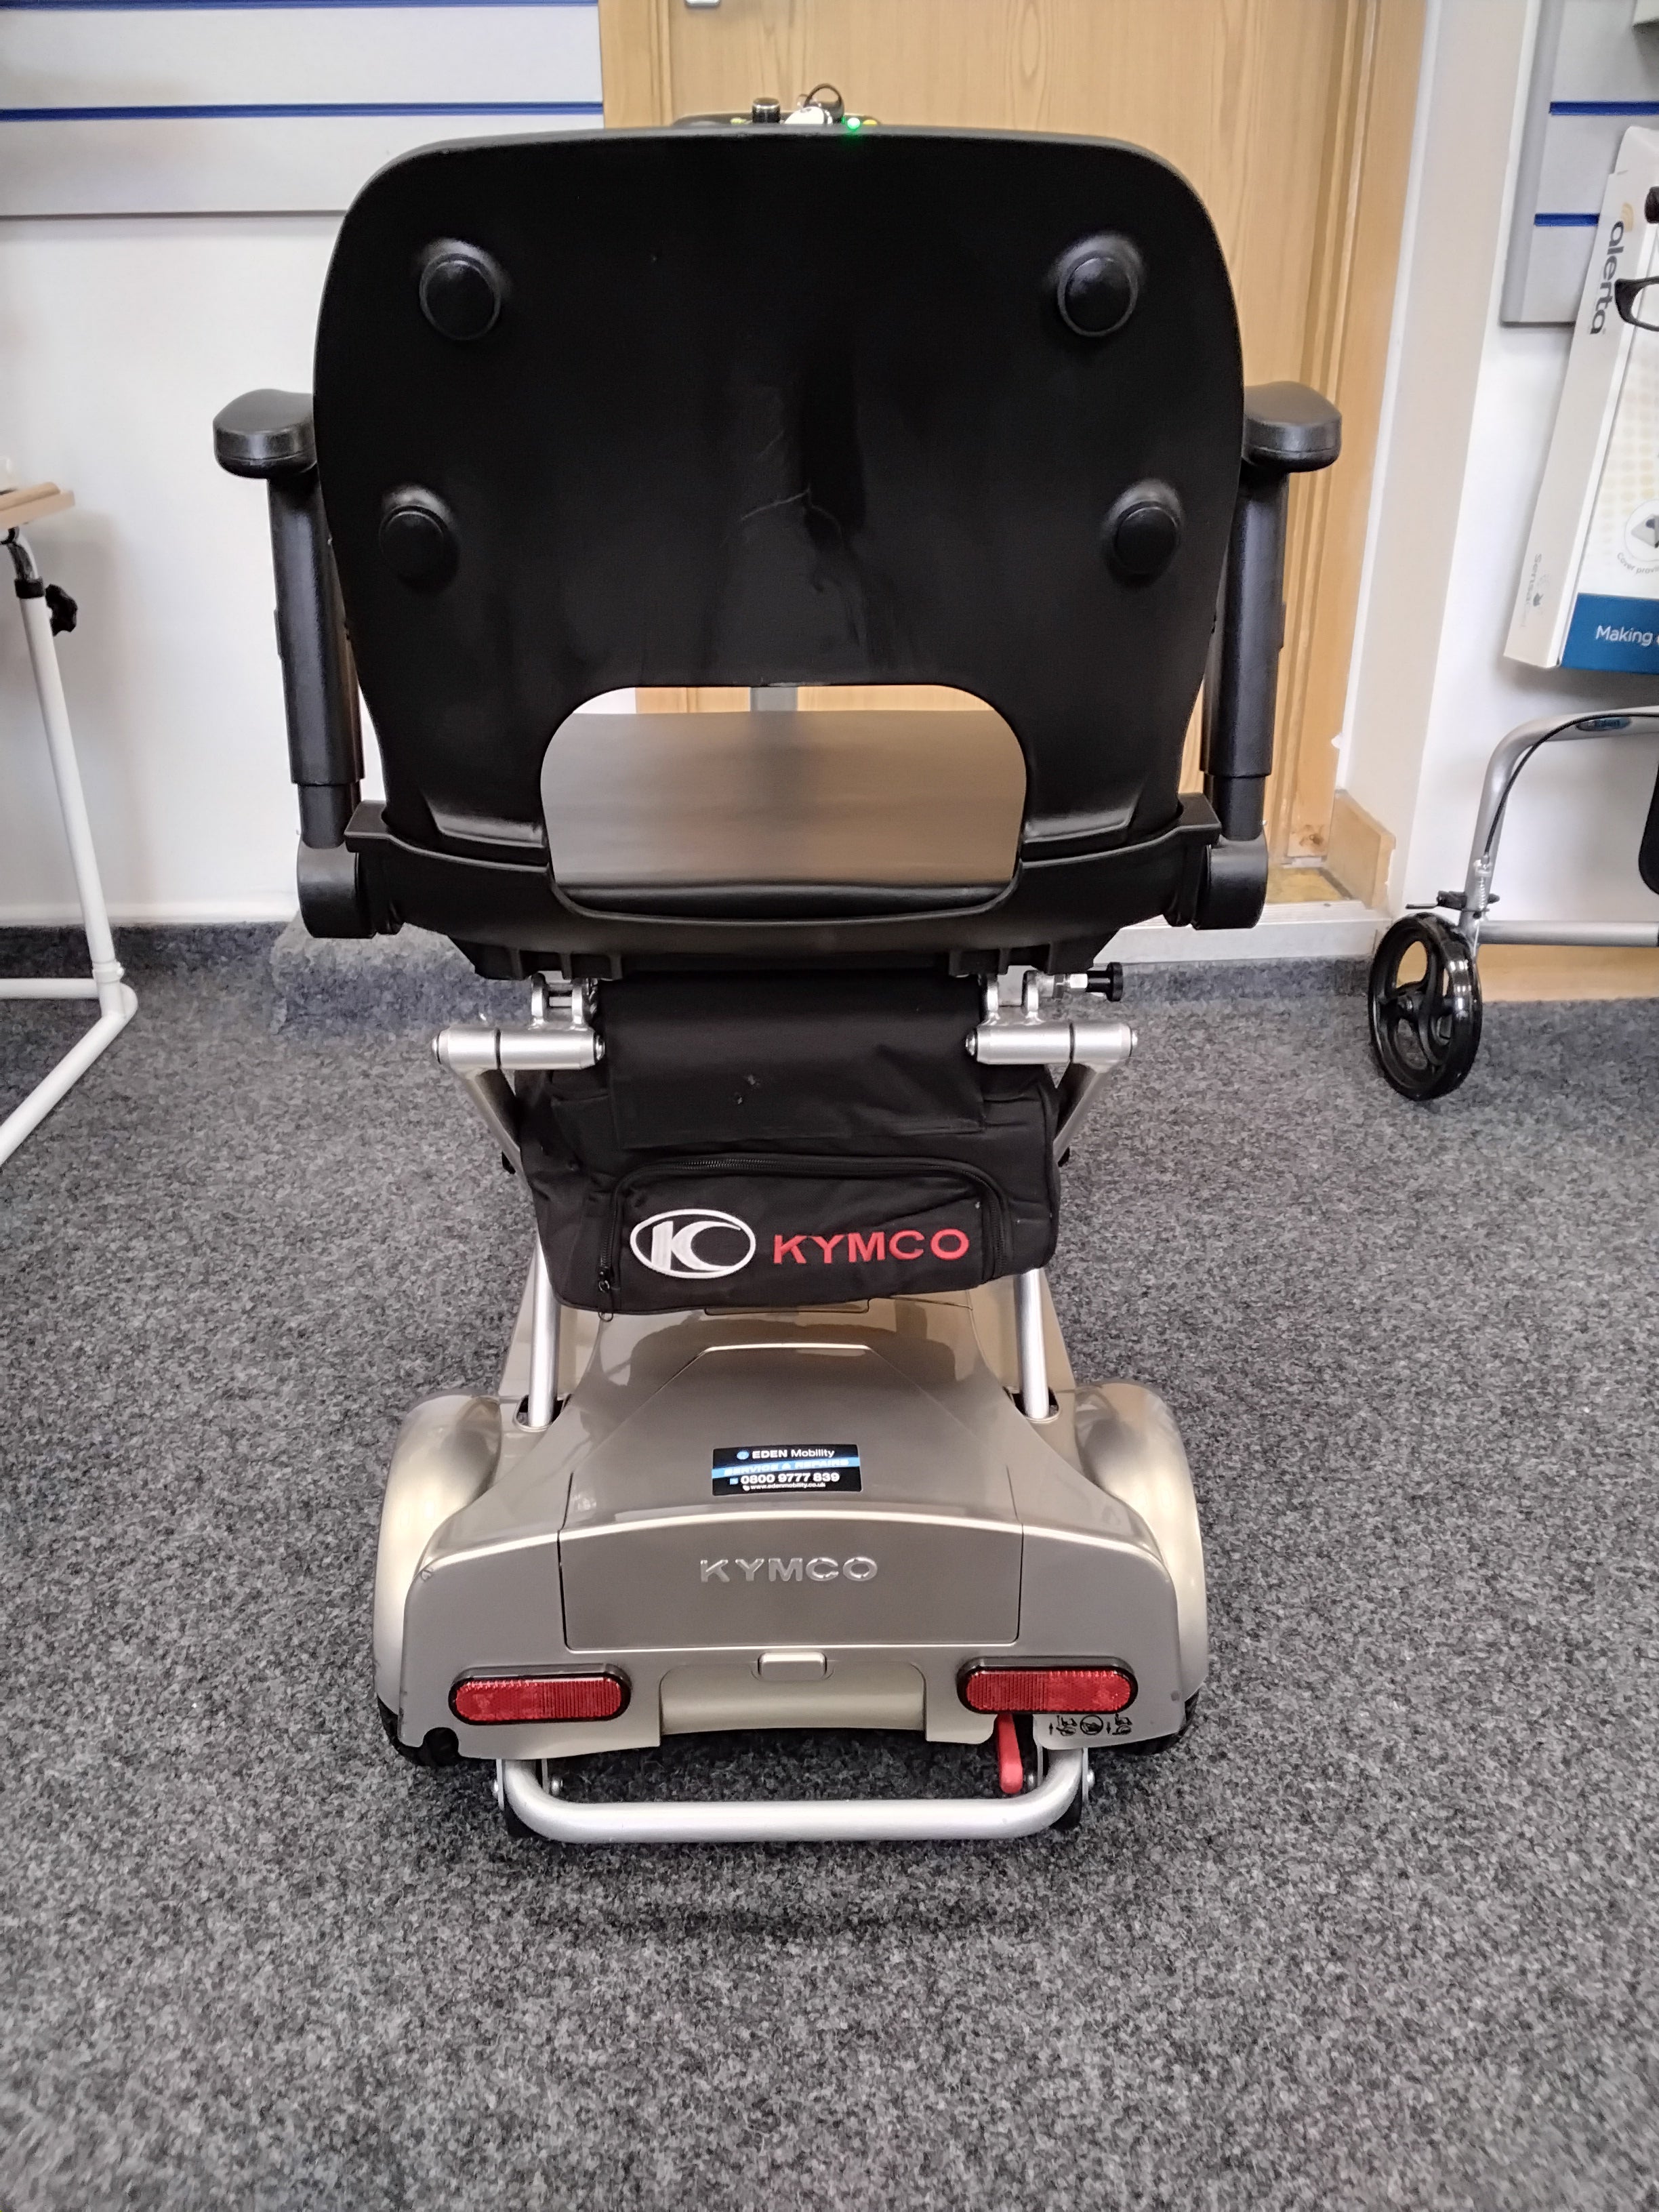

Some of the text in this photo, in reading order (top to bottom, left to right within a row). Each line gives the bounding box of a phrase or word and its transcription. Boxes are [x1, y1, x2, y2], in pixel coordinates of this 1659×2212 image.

[1590, 220, 1624, 334] alerta
[1617, 552, 1635, 571] Cover
[1596, 625, 1653, 647] Making
[773, 1228, 970, 1265] KYMCO
[752, 1449, 834, 1459] EDEN Mobility
[724, 1464, 779, 1476] SERVICE
[794, 1459, 848, 1469] REPAIRS
[741, 1472, 840, 1484] 0800 9777 839
[700, 1556, 878, 1582] KYMCO
